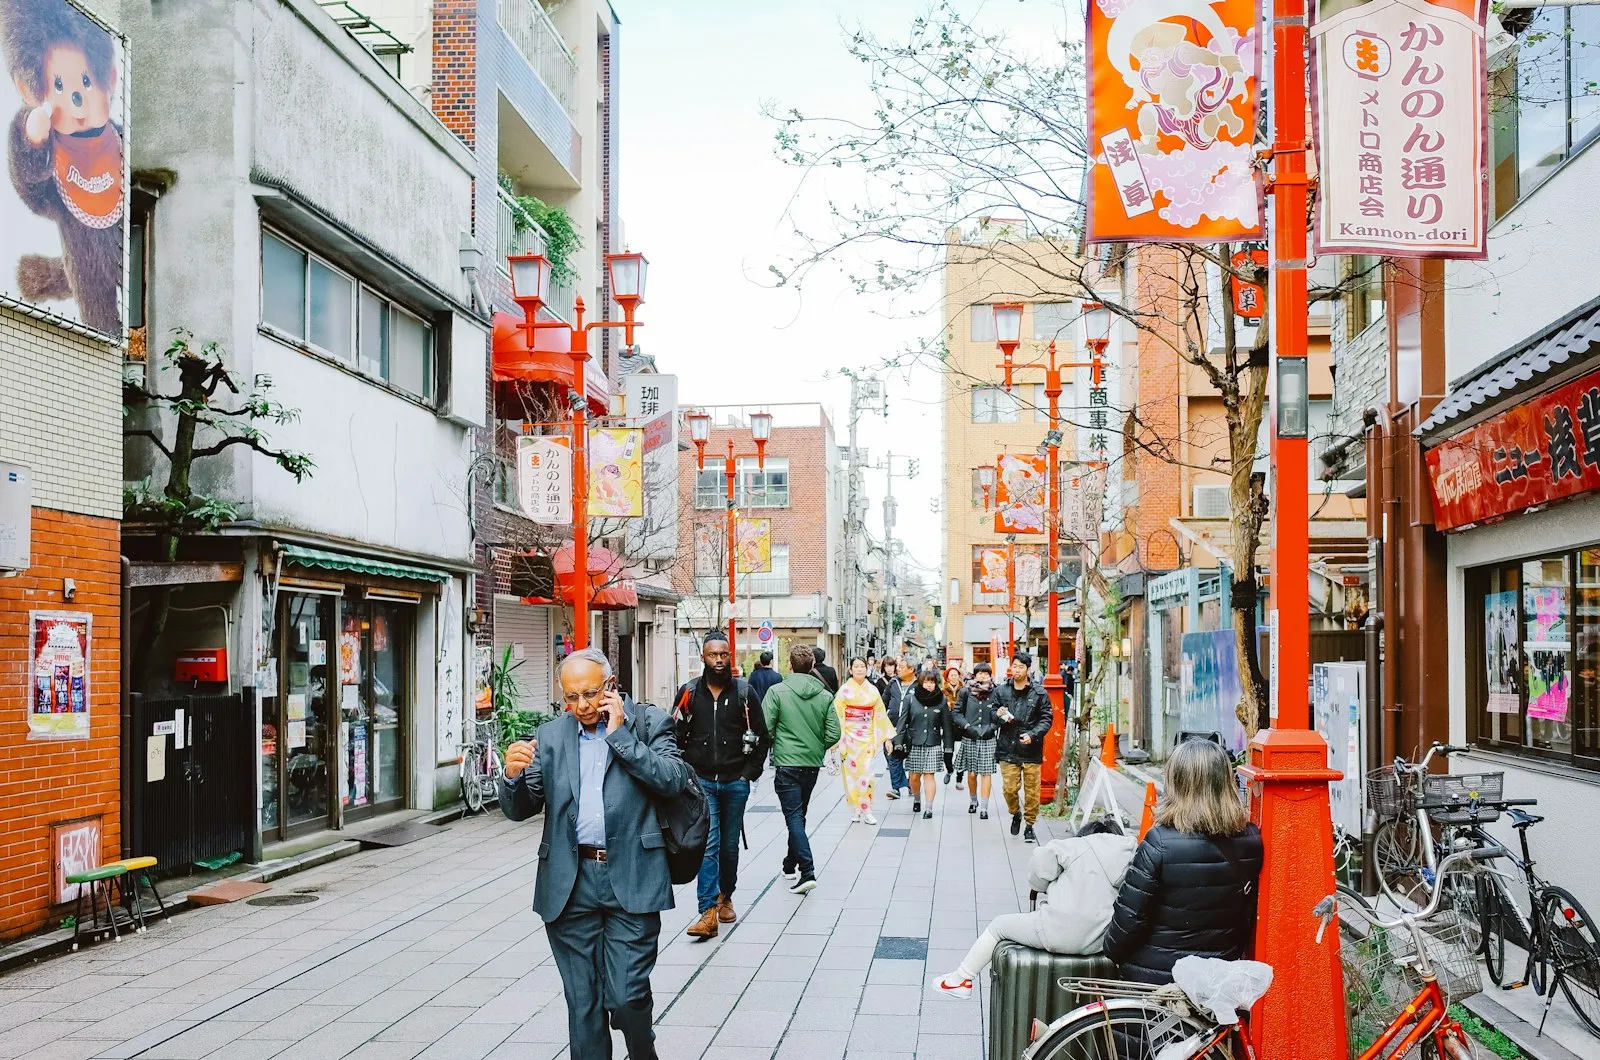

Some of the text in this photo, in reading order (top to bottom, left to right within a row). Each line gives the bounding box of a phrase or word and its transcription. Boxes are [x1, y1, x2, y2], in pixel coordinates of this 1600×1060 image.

[1359, 89, 1384, 218] メトロ商店会
[1400, 21, 1446, 225] かんのん通り
[1106, 138, 1149, 208] 浅草
[1339, 223, 1468, 241] Kannon-dori
[641, 386, 659, 415] 珈琲
[546, 448, 561, 516] かんのん通り
